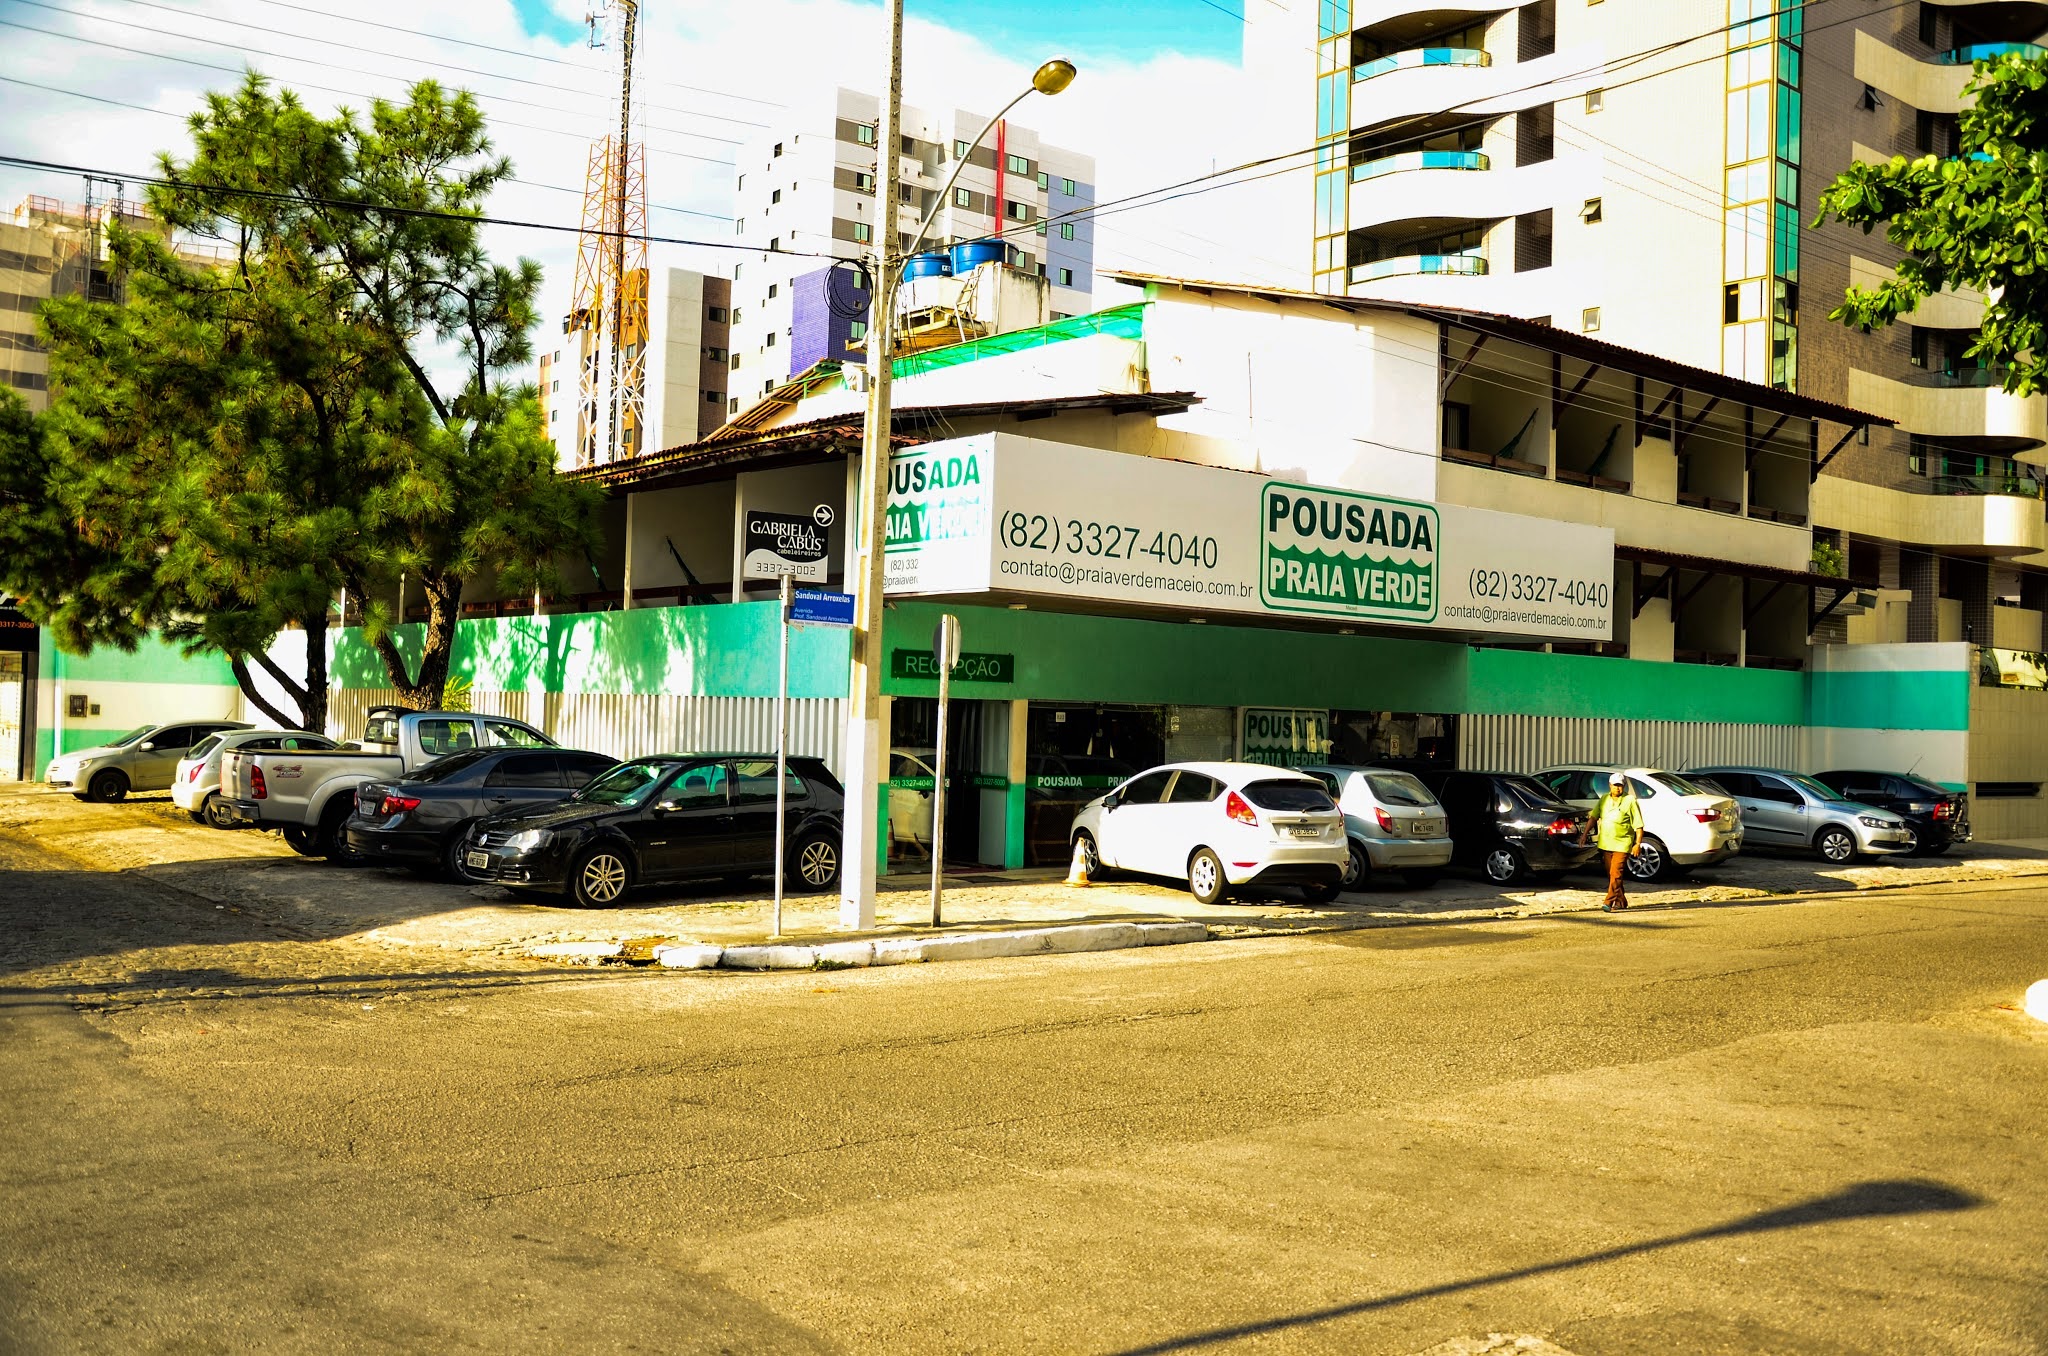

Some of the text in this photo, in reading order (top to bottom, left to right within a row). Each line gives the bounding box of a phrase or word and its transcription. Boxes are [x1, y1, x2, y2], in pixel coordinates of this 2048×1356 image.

[888, 454, 980, 496] USADA
[751, 520, 815, 538] GABRIELA
[885, 513, 912, 540] AIA
[1269, 493, 1433, 552] POUSADA
[1000, 510, 1218, 569] (82) 3327-4040
[756, 563, 816, 575] 3337-3002
[1000, 560, 1253, 598] contato@praiaverdemaceio.com.br
[1270, 557, 1430, 606] PRAIA VERDE
[795, 591, 850, 603] Sandoval Arroxelas
[1469, 568, 1608, 608] (82) 3327-4040
[1444, 605, 1607, 629] contato@praiaverdemaceio.com.br
[905, 656, 1000, 679] RECPÇÃO
[1038, 777, 1083, 787] POUSADA
